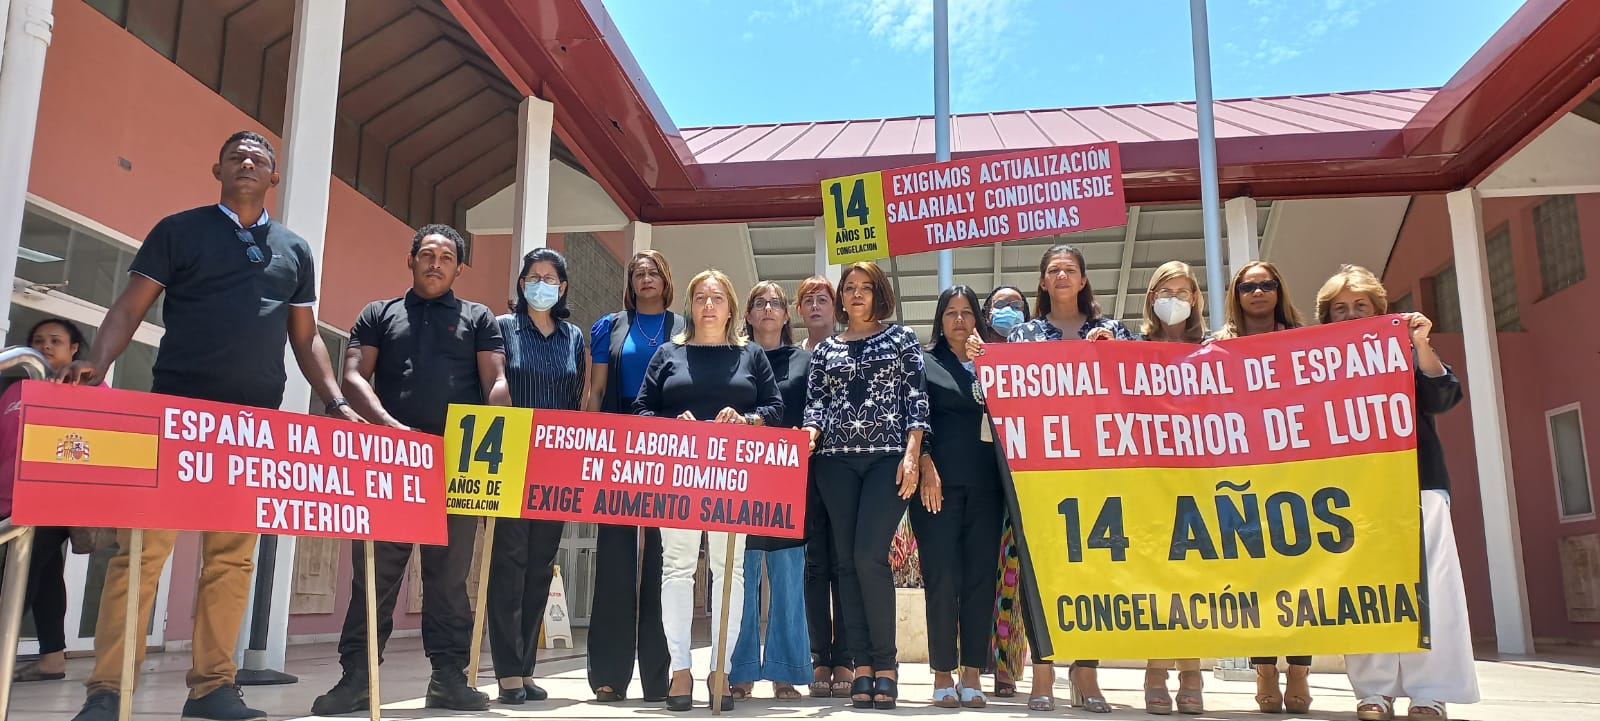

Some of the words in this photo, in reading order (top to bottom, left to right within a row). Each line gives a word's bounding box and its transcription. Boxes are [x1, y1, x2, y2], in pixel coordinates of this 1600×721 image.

[892, 165, 971, 197] EXIGIMOS
[979, 146, 1112, 185] ACTUALIZACIÓN
[830, 178, 869, 229] 14
[924, 216, 1010, 245] TRABAJOS
[1017, 205, 1081, 233] DIGNAS
[835, 226, 860, 244] AÑOS
[863, 225, 876, 239] DE
[836, 242, 878, 256] CONGELACION
[980, 361, 1109, 399] PERSONAL
[1118, 360, 1235, 396] LABORAL
[1243, 354, 1281, 391] DE
[1291, 332, 1408, 386] ESPAÑA
[163, 408, 275, 450] ESPAÑA
[287, 423, 321, 456] HA
[332, 429, 434, 470] OLVIDADO
[458, 413, 506, 475] 14
[533, 424, 617, 454] PERSONAL
[625, 432, 700, 460] LABORAL
[707, 437, 727, 462] DE
[735, 437, 800, 468] ESPAÑA
[1043, 415, 1081, 458] EL
[1098, 411, 1248, 457] EXTERIOR
[1262, 404, 1306, 452] DE
[1324, 392, 1415, 445] LUTO
[178, 450, 213, 484] SU
[228, 458, 355, 496] PERSONAL
[365, 471, 393, 500] EN
[403, 475, 427, 504] EL
[448, 476, 481, 497] AÑOS
[486, 480, 502, 497] DE
[581, 456, 604, 482] EN
[611, 459, 666, 486] SANTO
[672, 464, 748, 492] DOMINGO
[256, 497, 370, 535] EXTERIOR
[446, 496, 499, 512] CONGELACION
[527, 484, 584, 514] EXIGE
[592, 489, 691, 522] AUMENTO
[700, 496, 796, 530] SALARIAL
[1057, 496, 1129, 563] 14
[1168, 479, 1355, 561] AÑOS
[1057, 584, 1260, 632] CONGELACIÓN
